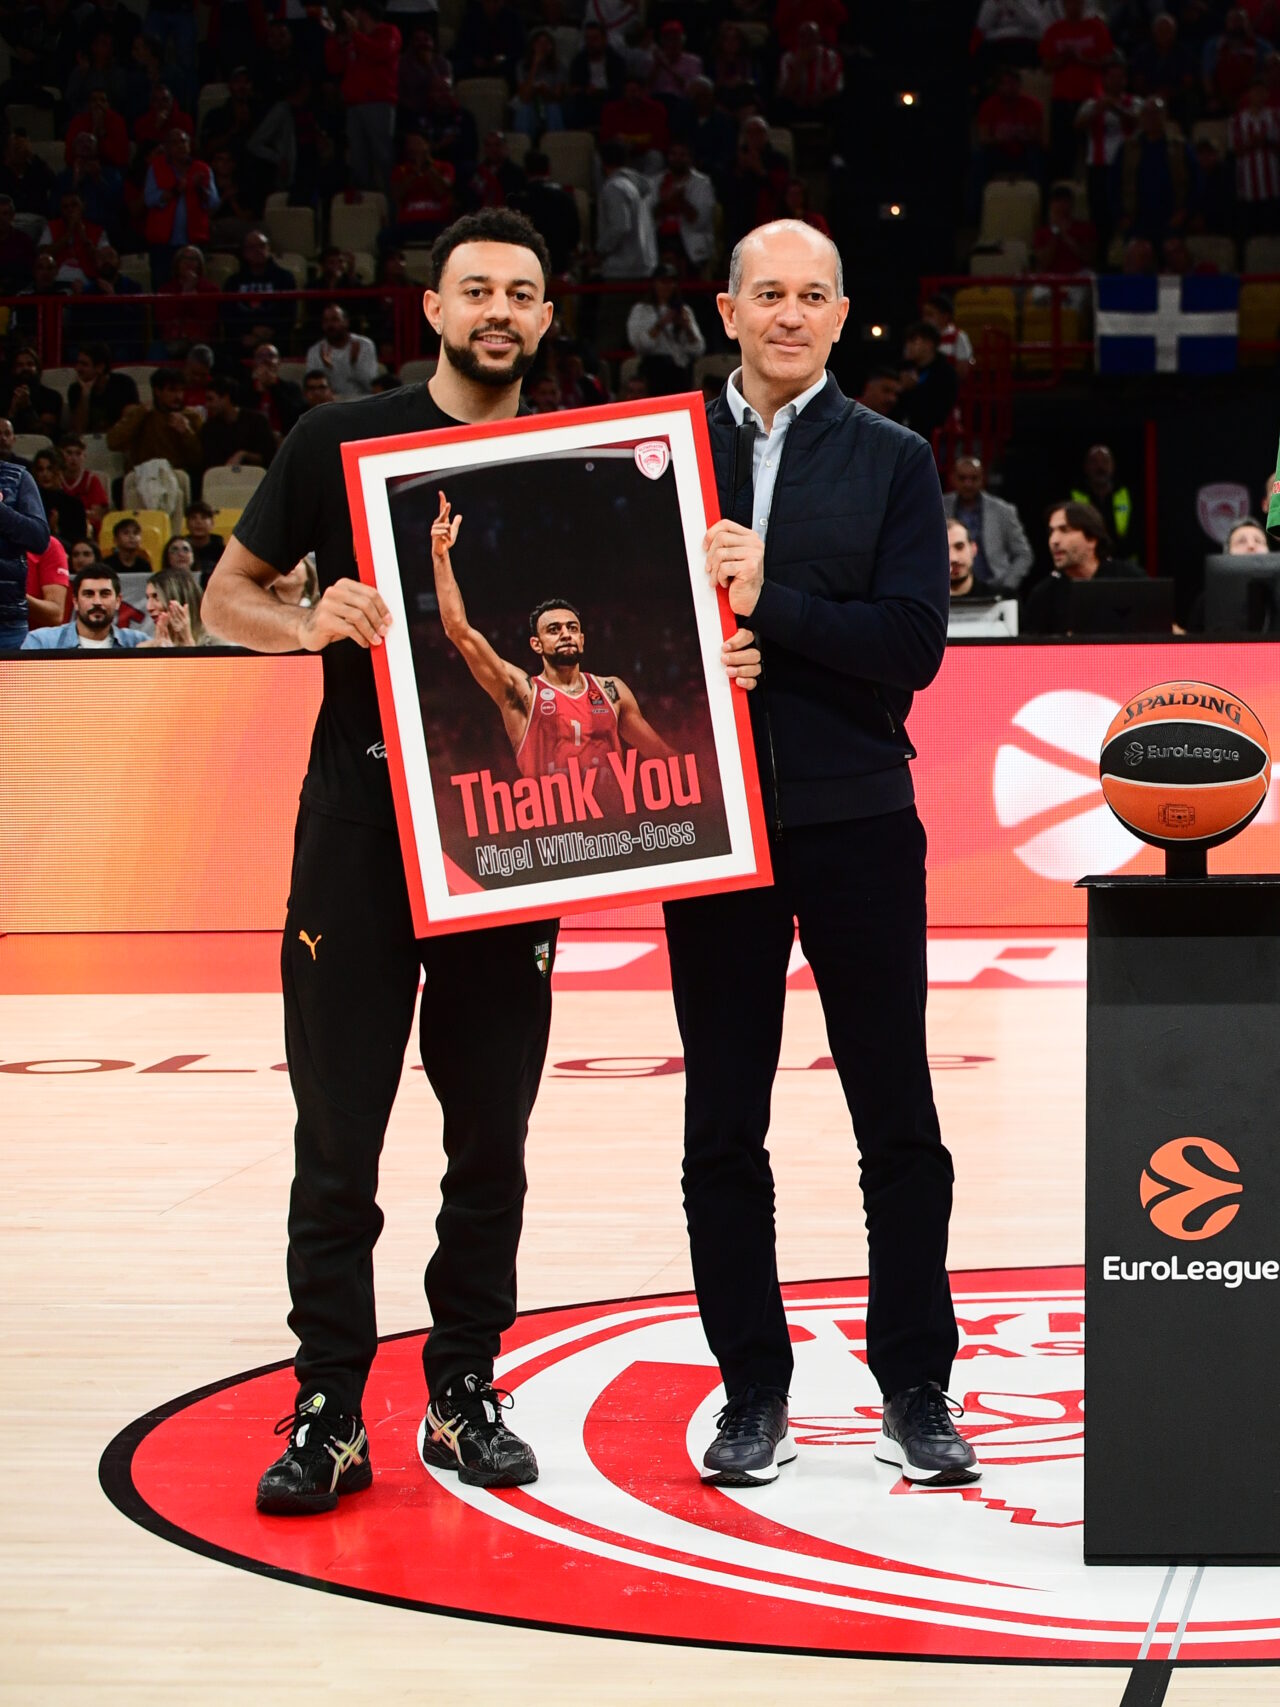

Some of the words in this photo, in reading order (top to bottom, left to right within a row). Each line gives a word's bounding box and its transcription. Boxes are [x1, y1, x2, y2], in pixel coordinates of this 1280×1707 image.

[1124, 693, 1241, 725] SPALDING
[570, 719, 581, 746] 1
[1147, 744, 1240, 763] EuroLeague
[451, 757, 604, 838] Thank
[607, 749, 701, 814] You
[475, 839, 534, 877] Nigel
[536, 821, 696, 867] Williams-Goss
[1103, 1256, 1280, 1289] EuroLeague
